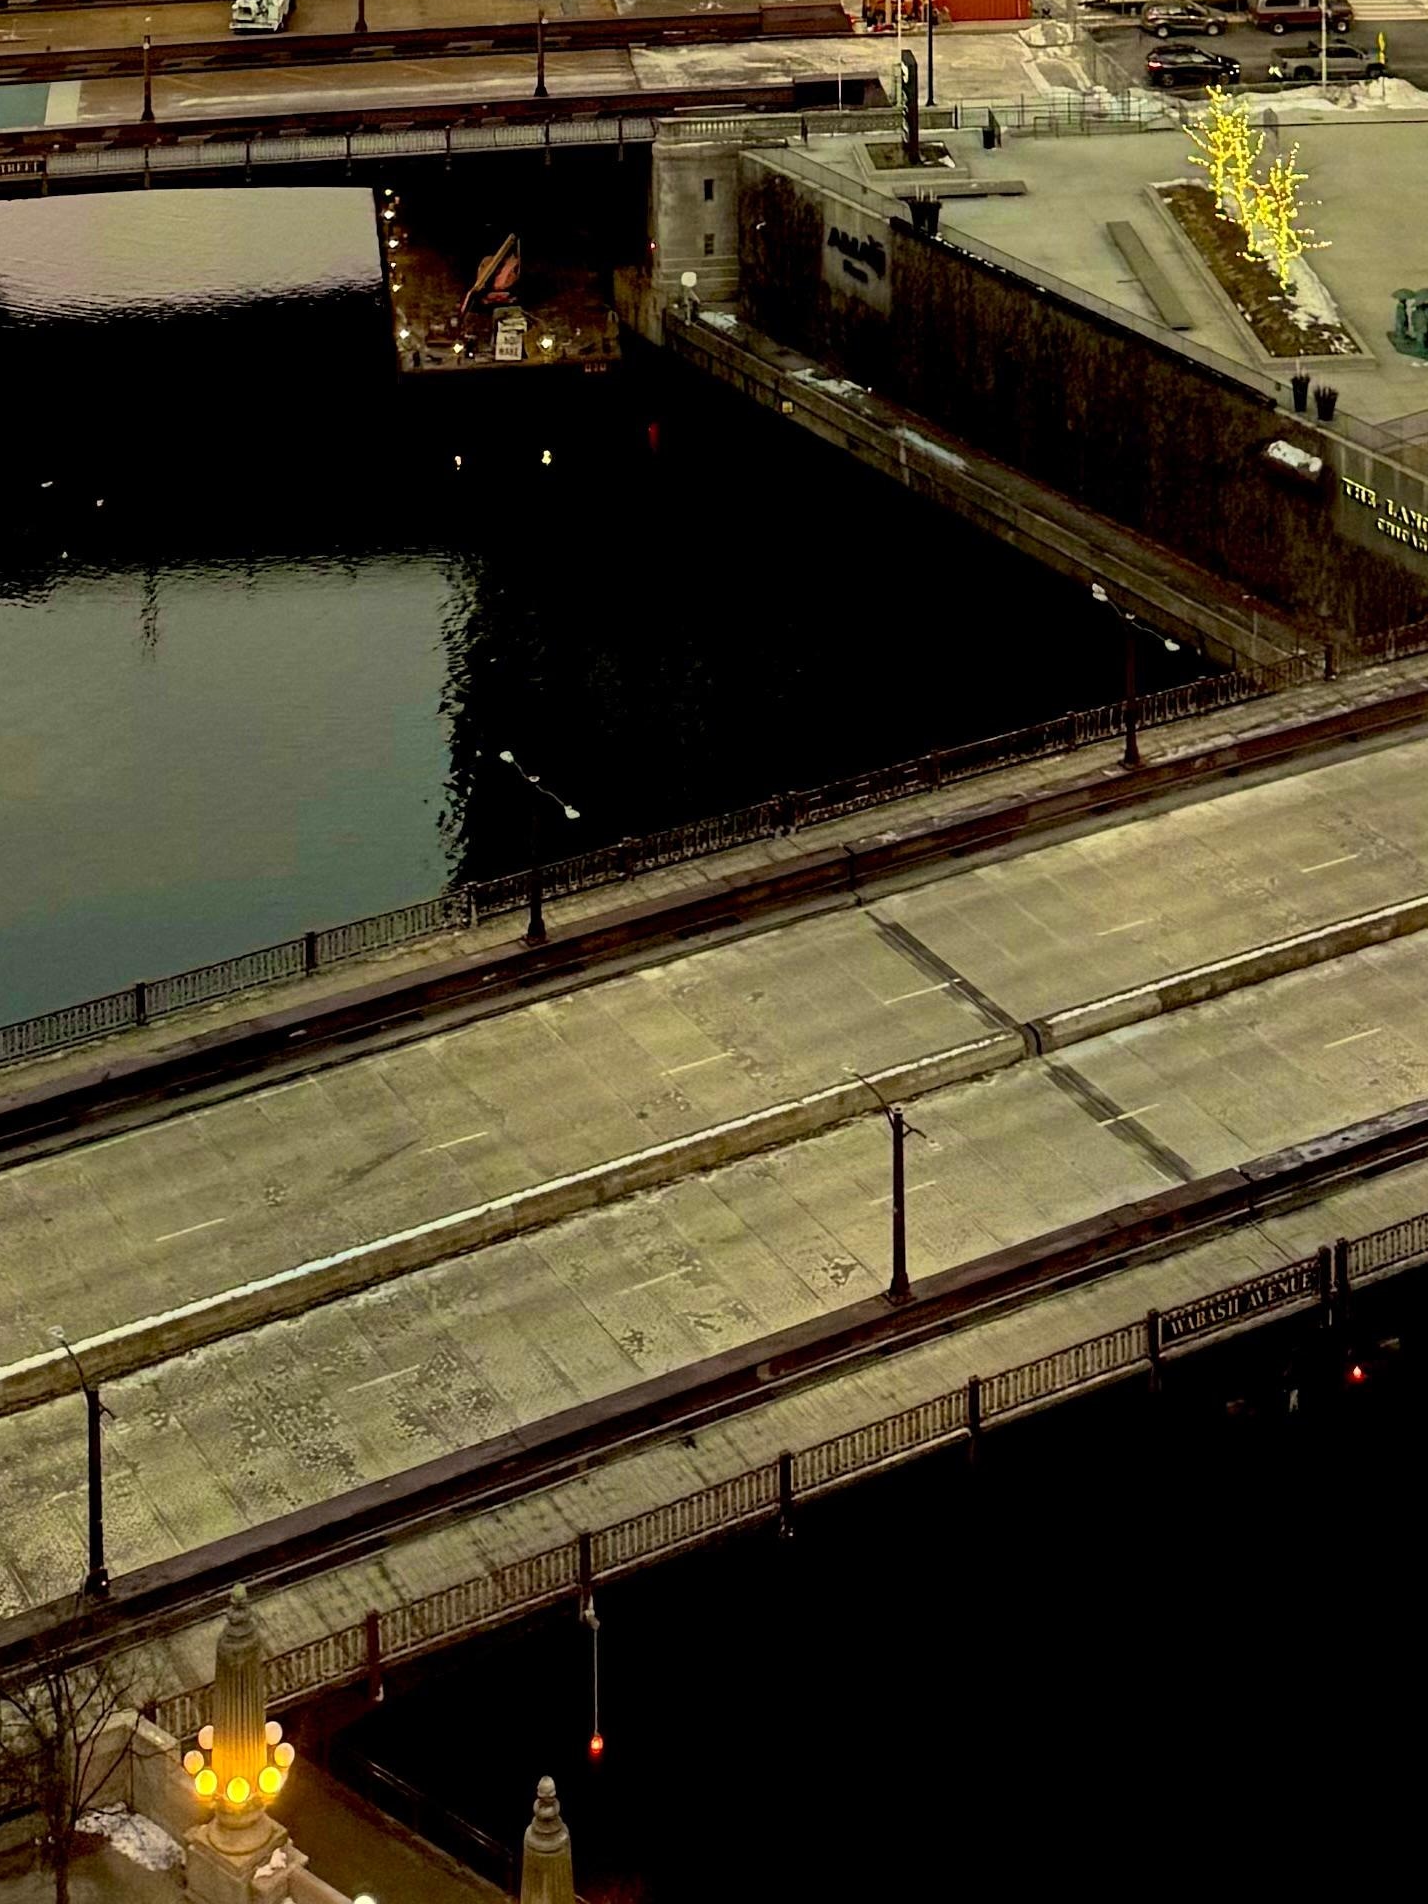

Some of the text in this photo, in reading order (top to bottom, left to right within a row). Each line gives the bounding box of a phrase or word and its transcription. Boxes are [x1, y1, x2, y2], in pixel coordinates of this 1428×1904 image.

[1341, 476, 1377, 508] THE
[1170, 1271, 1313, 1336] WABASH AVENUE
